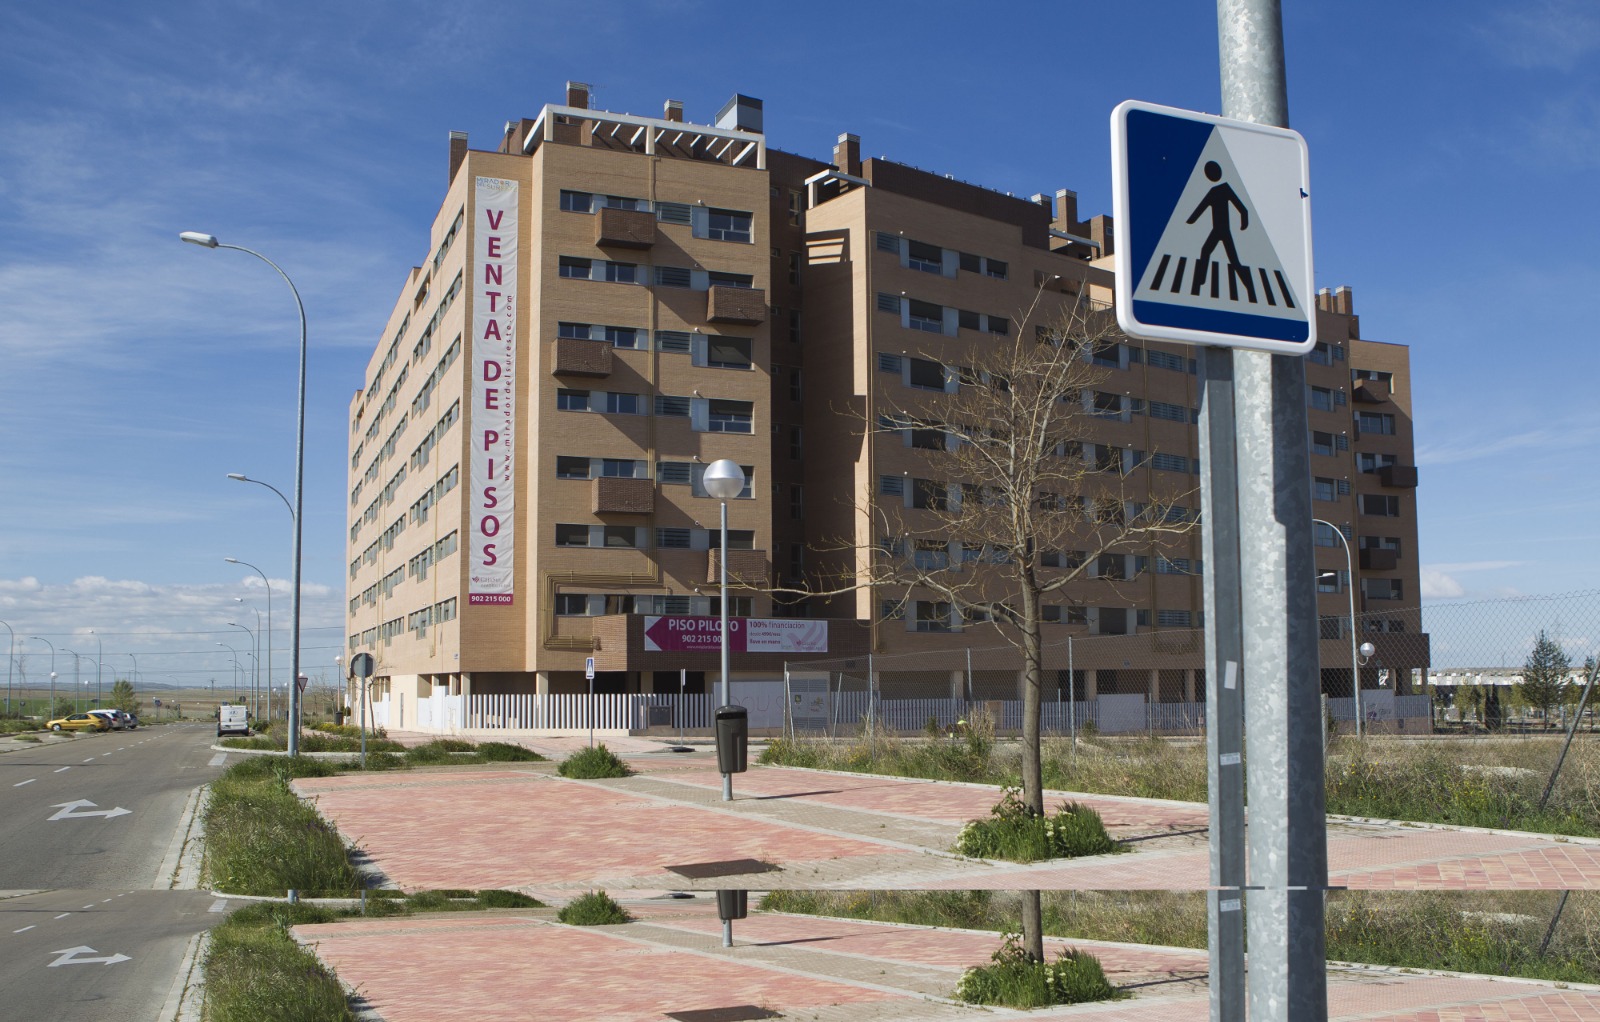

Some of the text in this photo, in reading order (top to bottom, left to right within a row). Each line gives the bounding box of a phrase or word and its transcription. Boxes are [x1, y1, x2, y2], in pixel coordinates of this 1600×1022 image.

[483, 209, 504, 341] VENTA
[483, 360, 502, 410] DE
[504, 295, 512, 482] www.miradordelsureste.com
[480, 430, 500, 566] PISOS
[668, 618, 739, 632] PISO PILOO
[682, 635, 722, 643] 902 215 00
[749, 621, 767, 629] 100%
